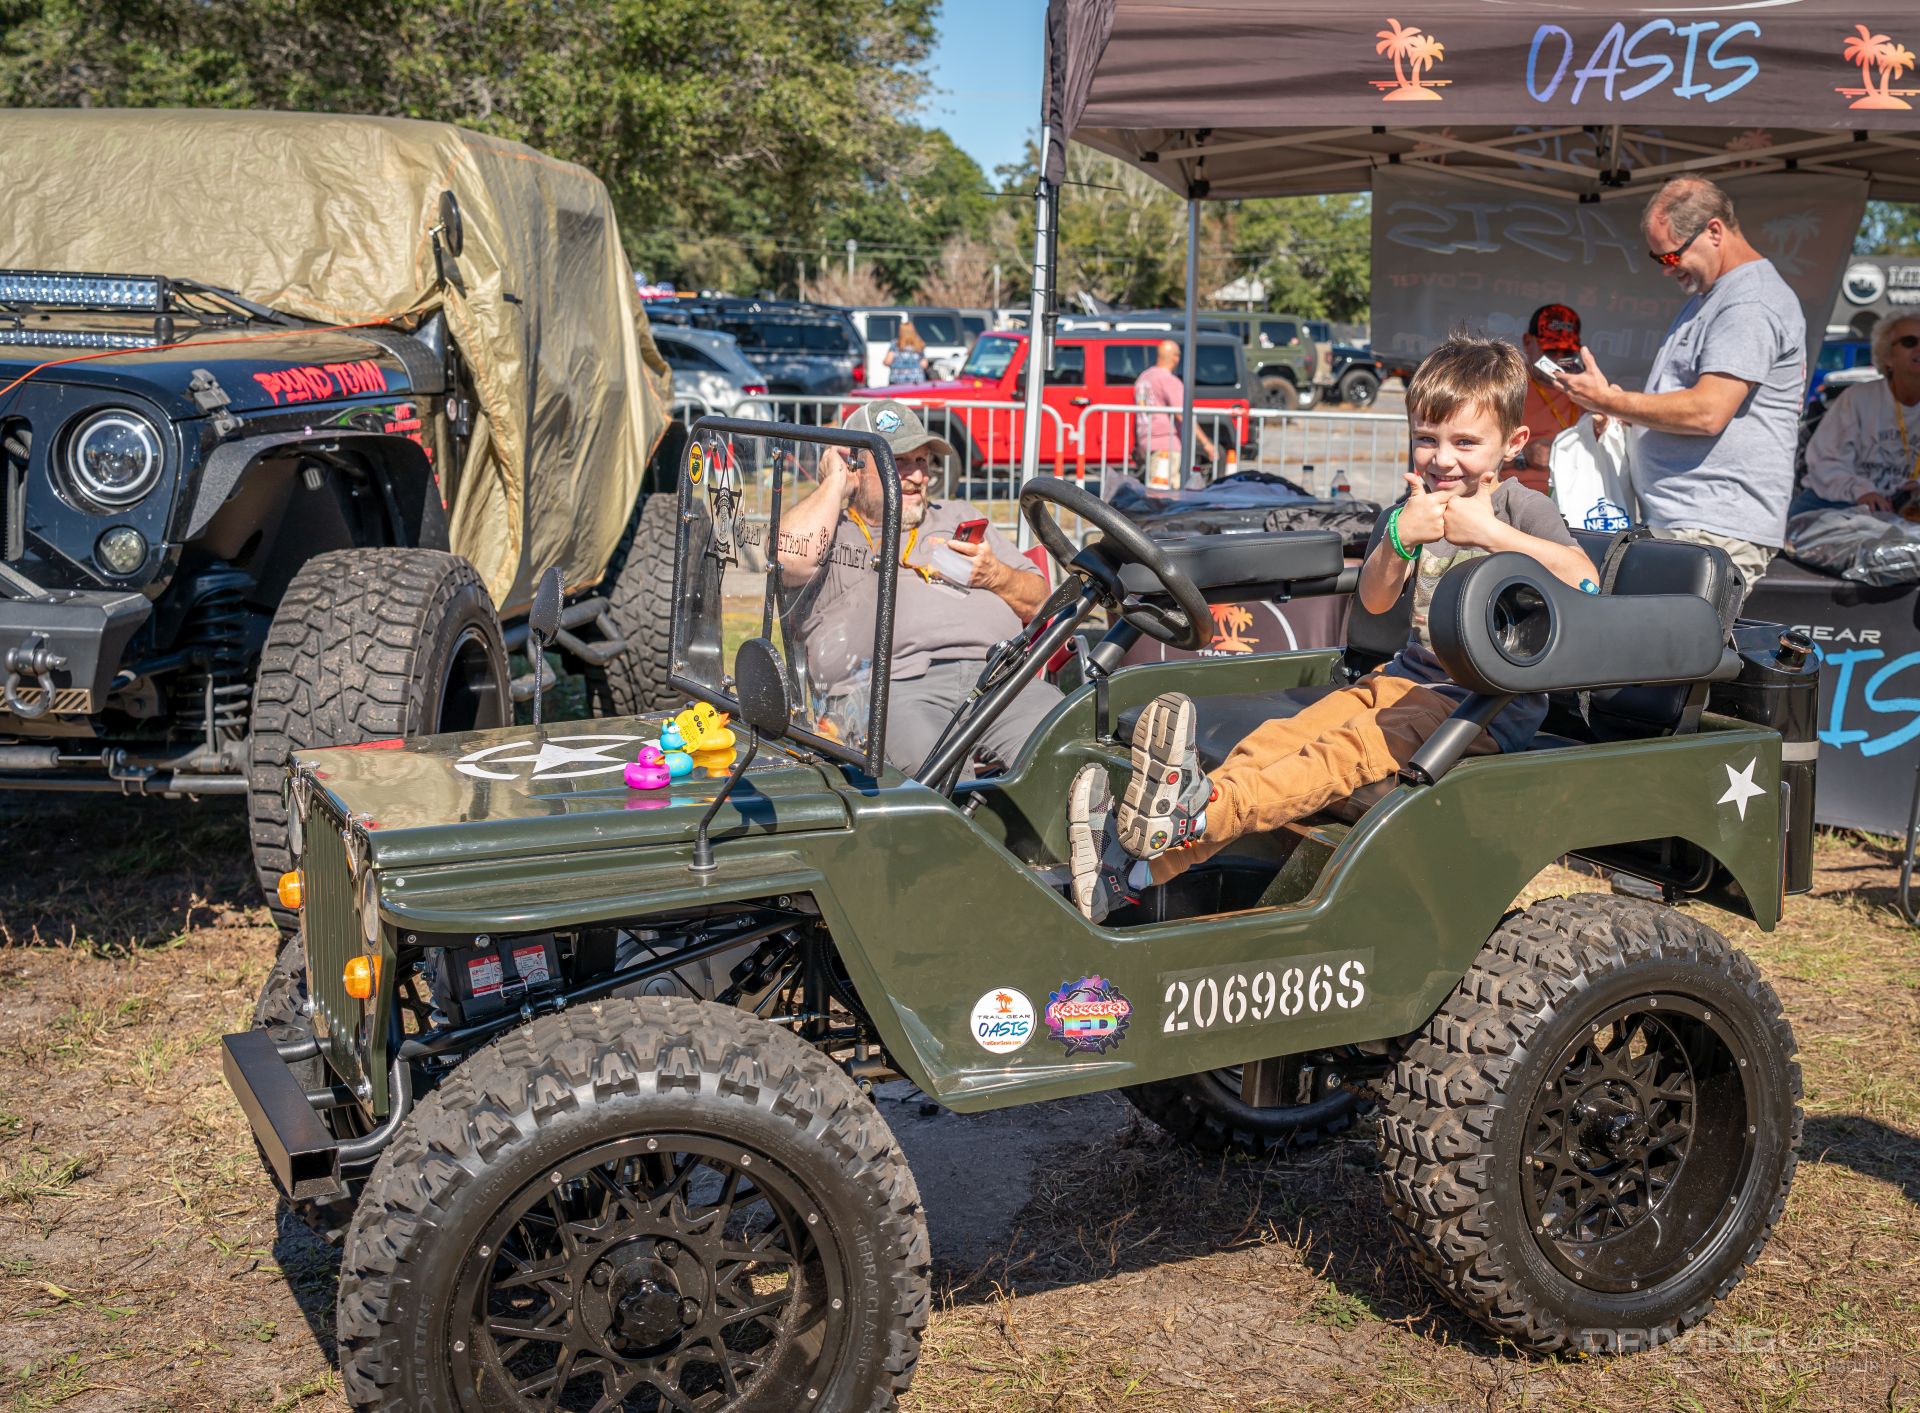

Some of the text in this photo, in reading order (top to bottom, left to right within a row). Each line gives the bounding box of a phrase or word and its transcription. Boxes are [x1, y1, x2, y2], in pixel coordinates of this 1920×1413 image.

[1526, 18, 1761, 104] OASIS
[323, 360, 387, 397] TOWN
[1789, 624, 1882, 644] GEAR
[1163, 960, 1365, 1033] 206986S
[978, 1020, 1029, 1038] OASIS
[854, 1222, 880, 1376] SIERRA CLASSIC
